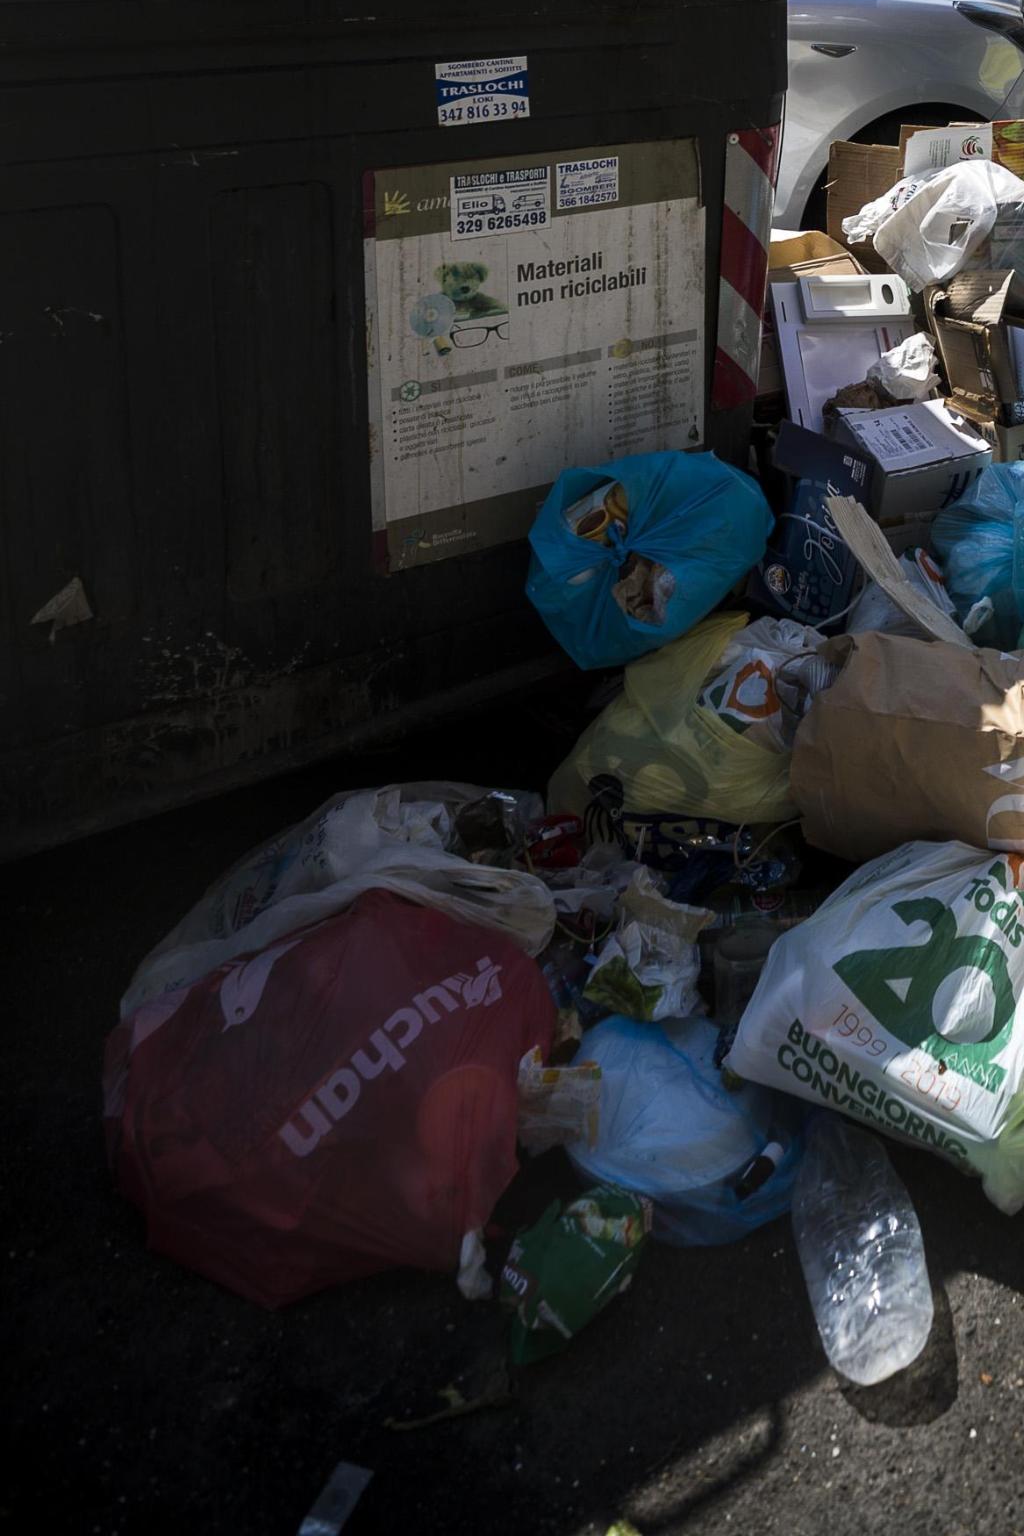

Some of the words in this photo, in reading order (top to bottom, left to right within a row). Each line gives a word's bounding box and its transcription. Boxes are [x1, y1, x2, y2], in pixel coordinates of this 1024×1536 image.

[440, 80, 523, 96] TRASLOCHI
[441, 108, 463, 122] 347
[467, 105, 489, 119] 816
[493, 103, 508, 116] 33
[511, 101, 526, 114] 94
[559, 159, 617, 174] TRASLOCHI
[457, 172, 498, 187] TRASLOCHI
[507, 168, 545, 184] TRASPORTI
[462, 200, 488, 210] Elio
[560, 198, 577, 208] 366
[579, 192, 617, 205] 1842570
[456, 218, 482, 234] 329
[487, 211, 546, 231] 6265498
[517, 251, 603, 283] Materiali
[517, 287, 554, 307] non
[560, 267, 647, 300] riciclabili
[279, 955, 503, 1158] Auchan
[830, 1004, 889, 1059] 1999
[900, 1057, 964, 1113] 2019
